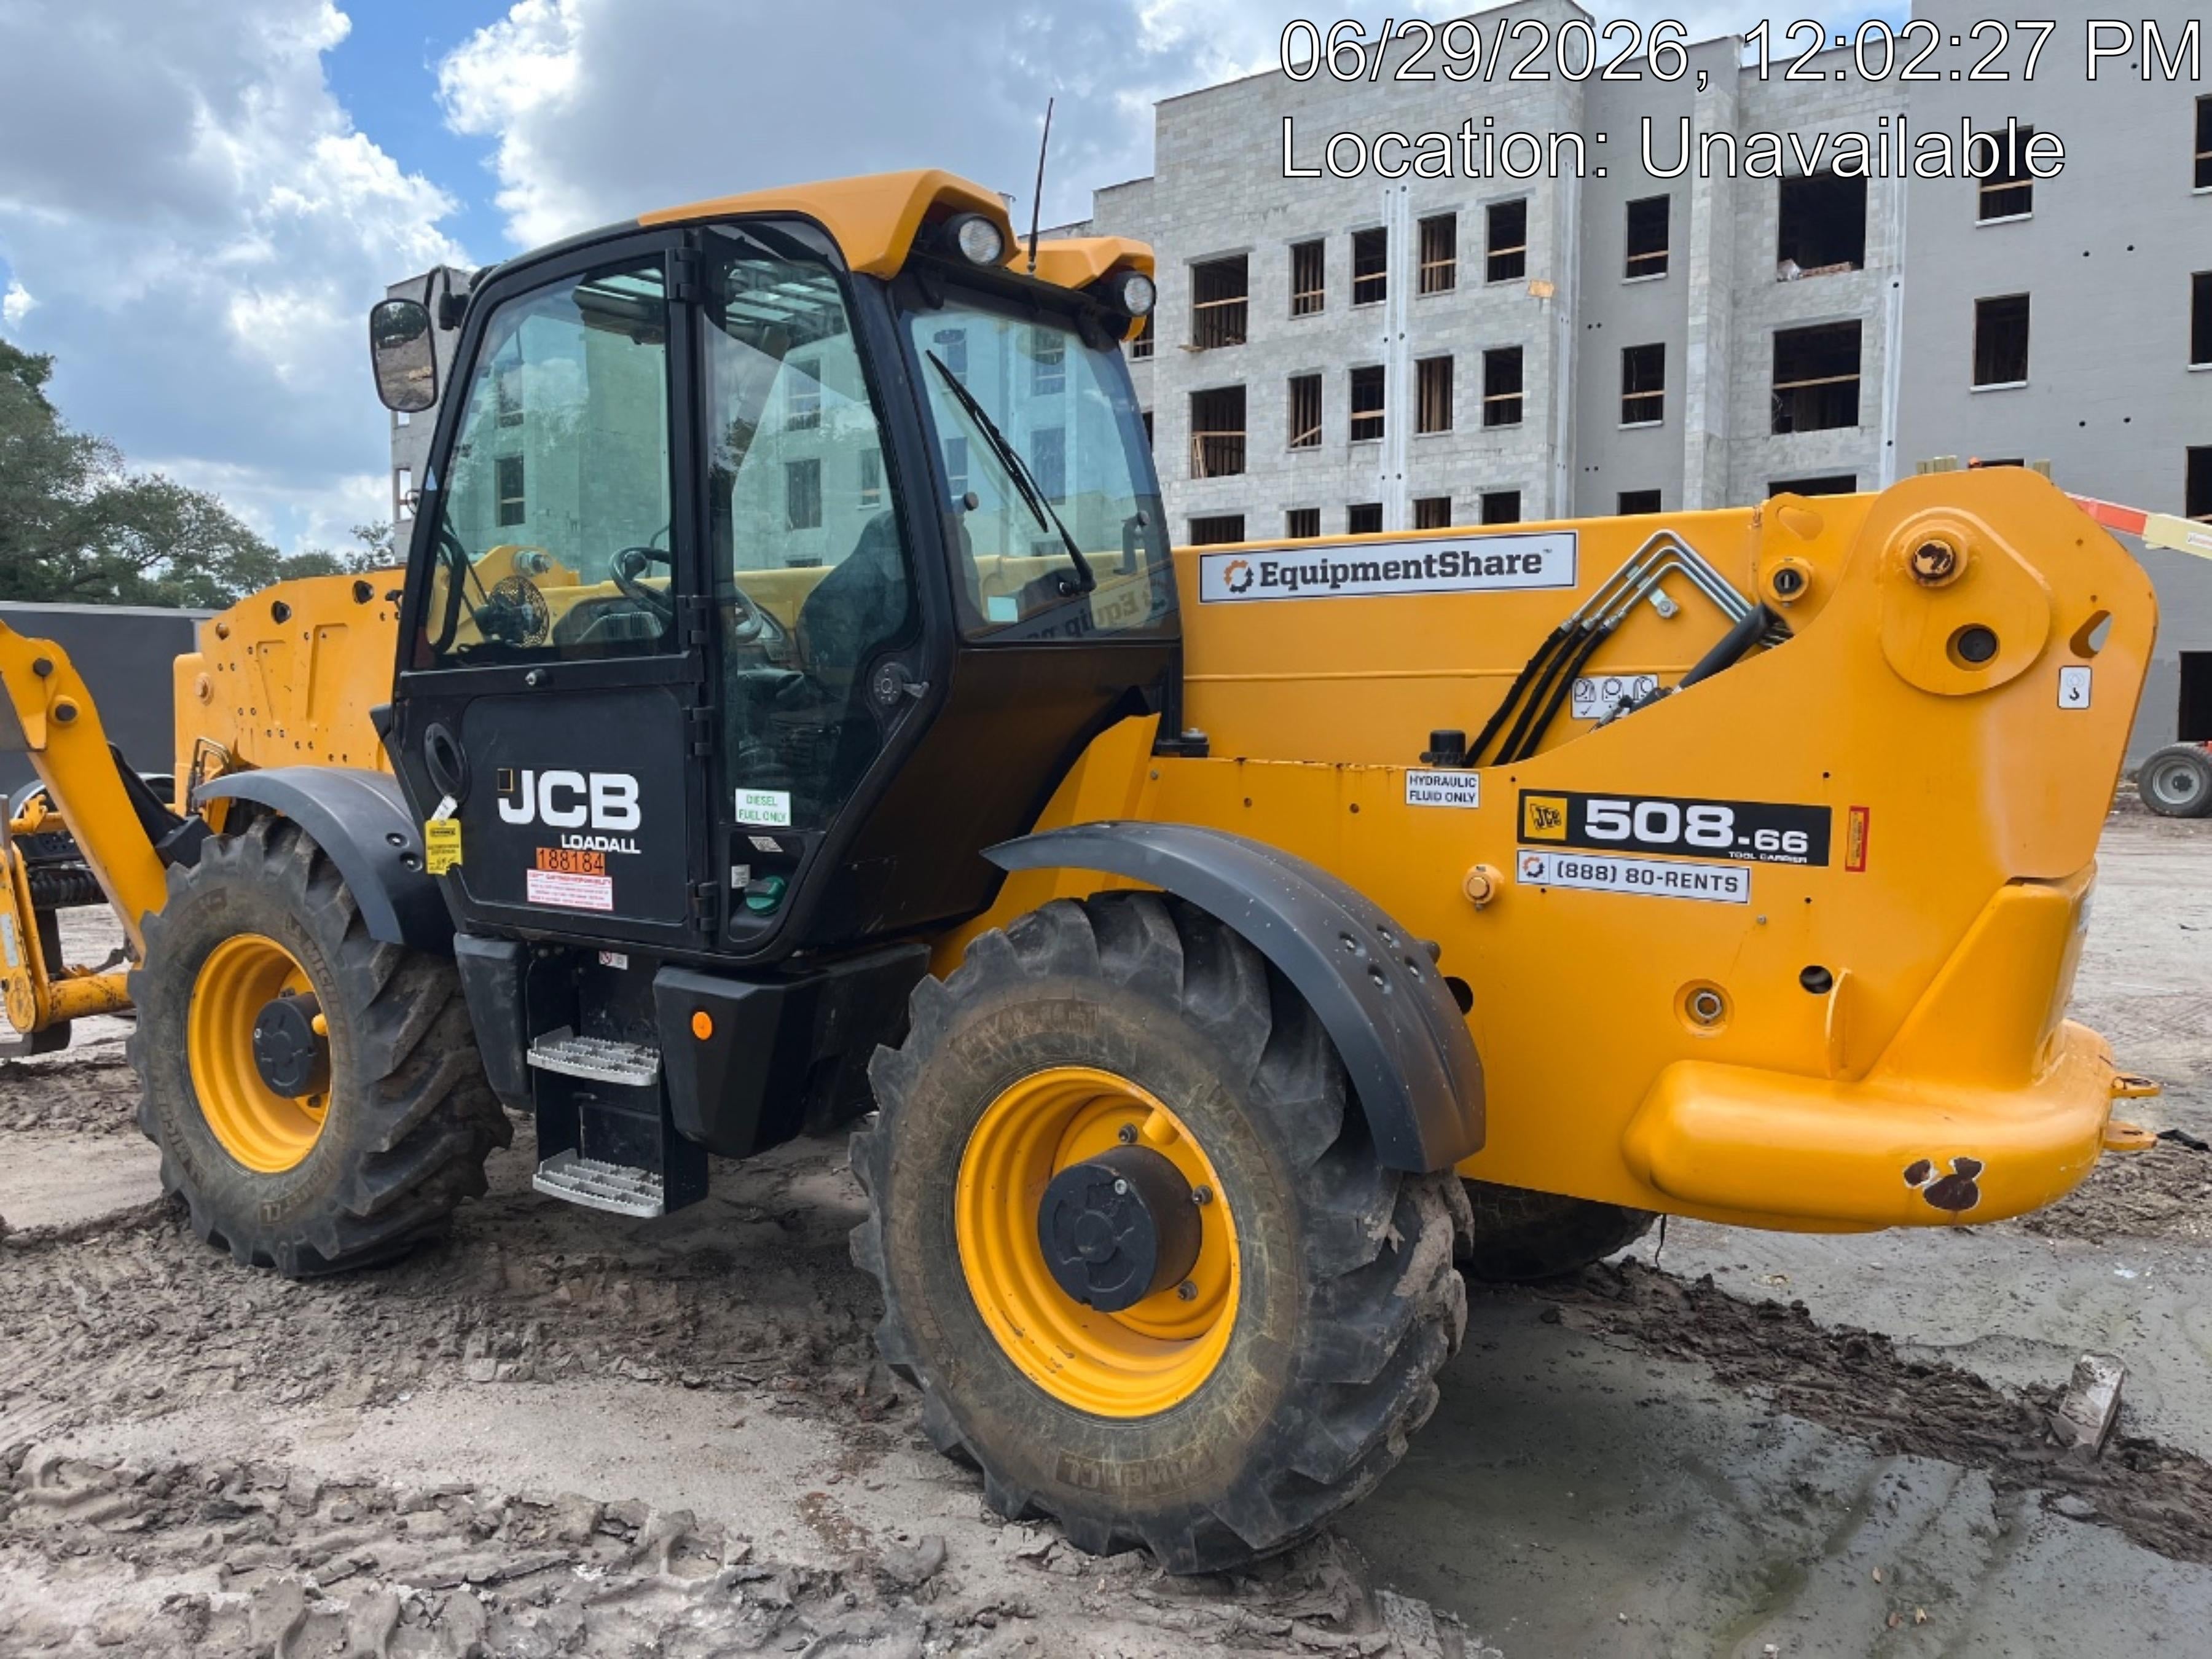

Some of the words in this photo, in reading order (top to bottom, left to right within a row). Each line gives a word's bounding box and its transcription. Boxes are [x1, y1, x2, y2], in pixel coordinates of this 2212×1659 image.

[1410, 774, 1477, 788] HYDRAULIC
[498, 770, 641, 831] JCB
[747, 794, 778, 807] DIESEL
[1410, 790, 1442, 802] FLUID
[1445, 791, 1476, 803] ONLY
[739, 809, 761, 821] FUEL
[763, 810, 786, 823] ONLY
[1531, 804, 1563, 831] JCB
[561, 834, 642, 854] LOADALL
[539, 849, 604, 873] 188184
[1558, 860, 1617, 884] (888)
[1625, 868, 1738, 893] 80-RENTS
